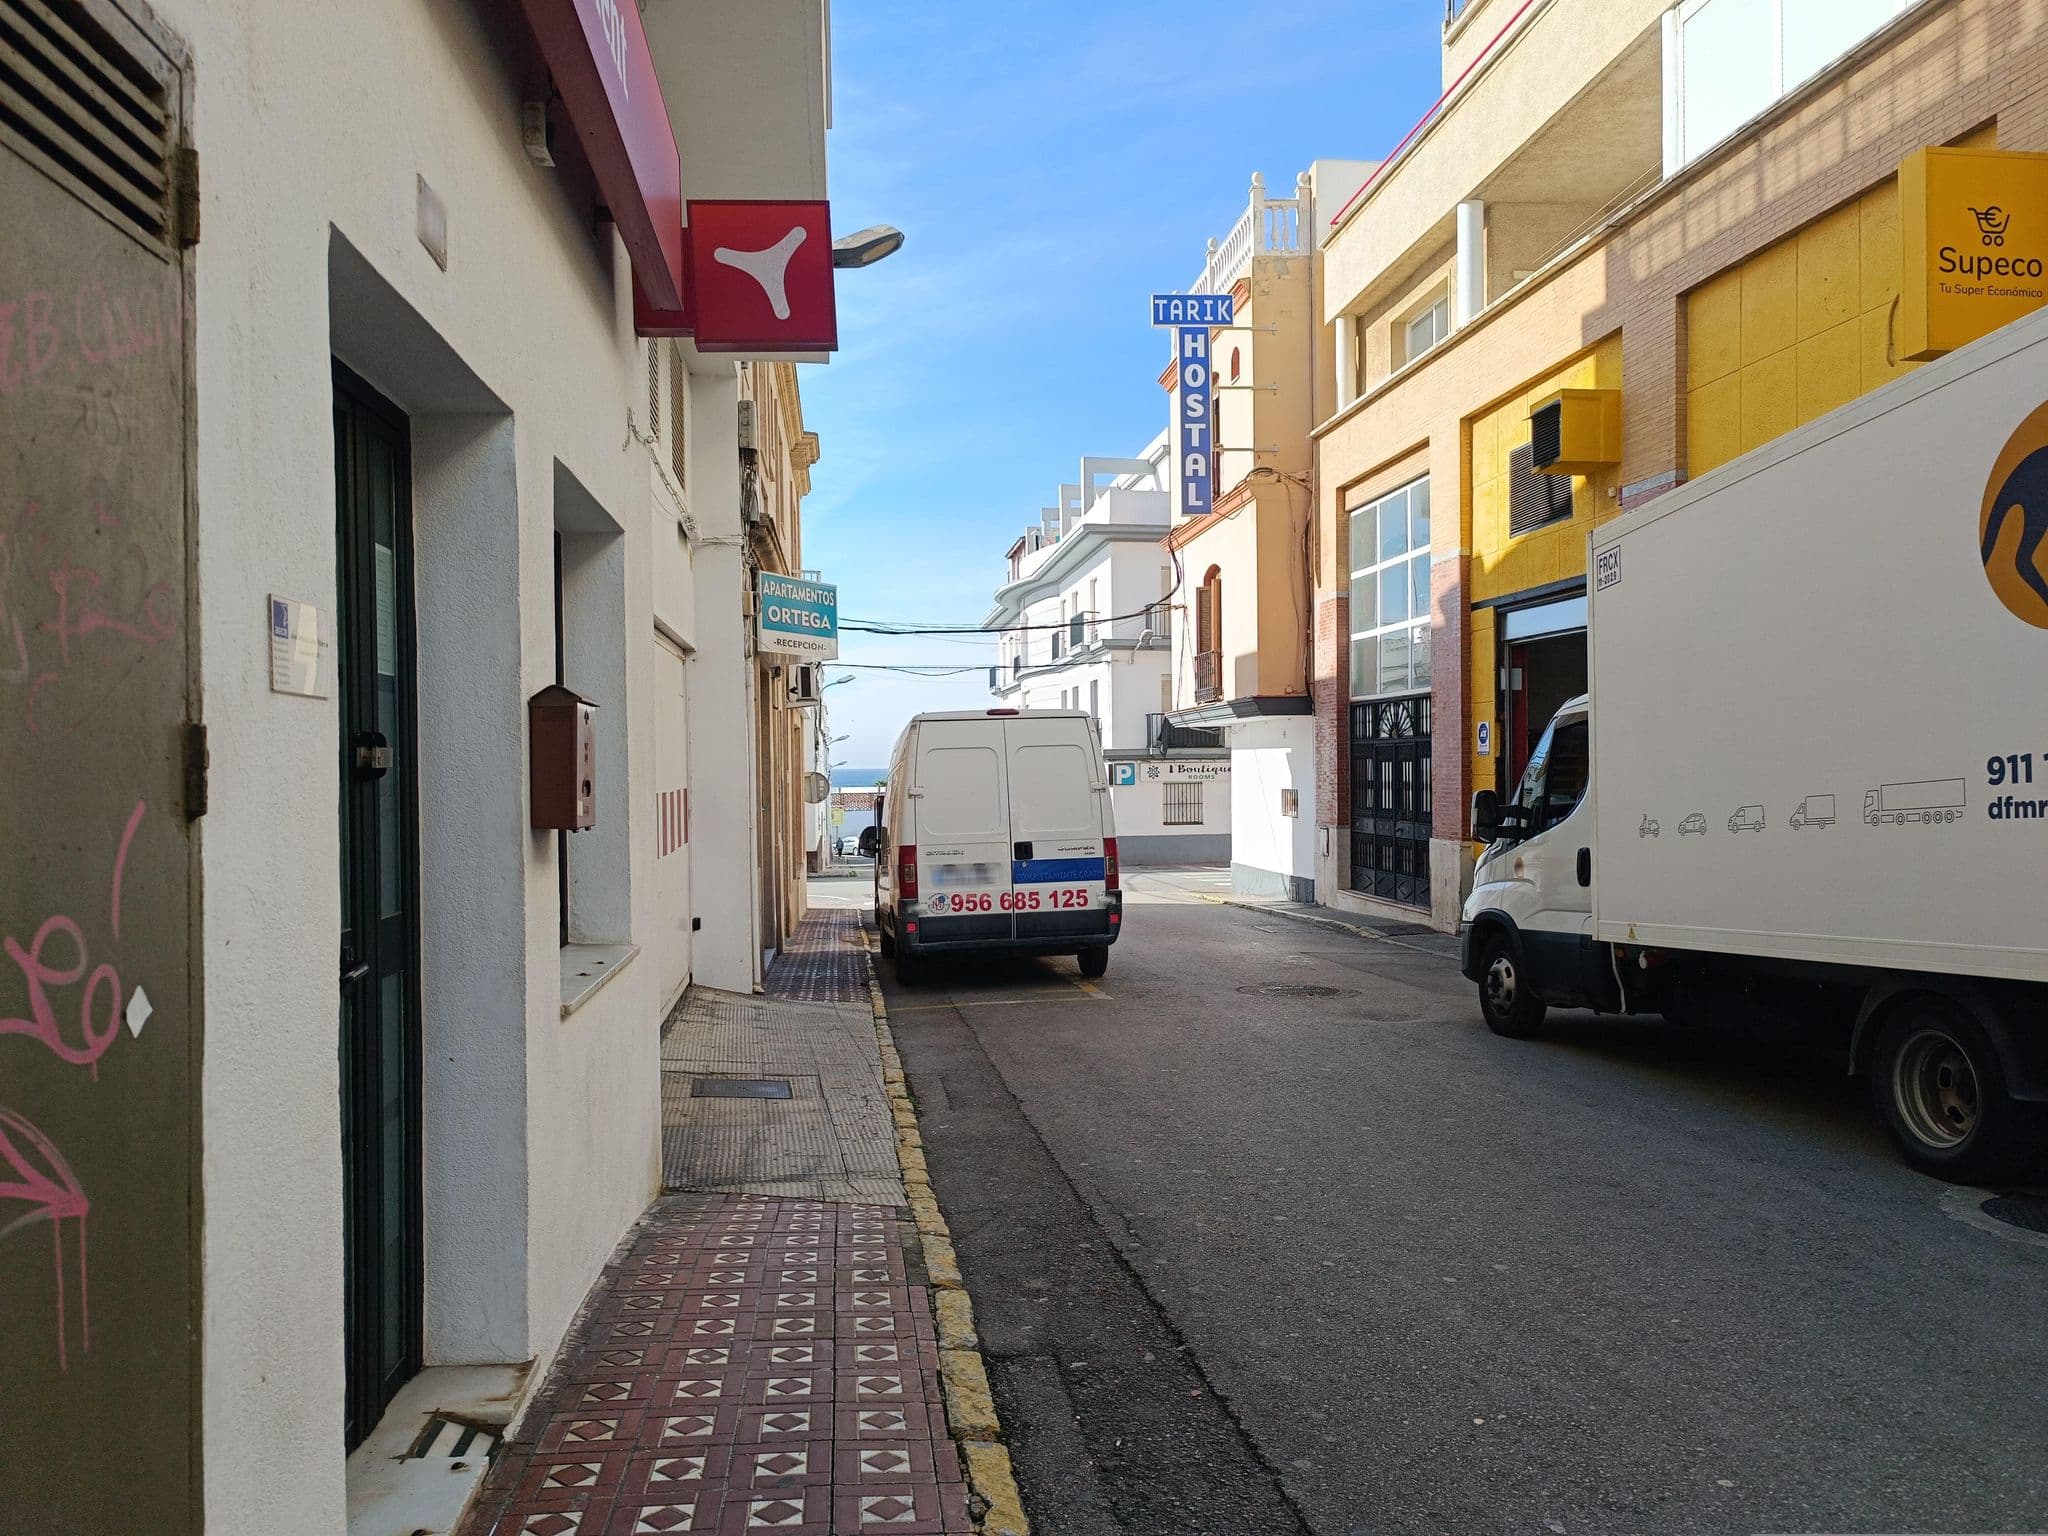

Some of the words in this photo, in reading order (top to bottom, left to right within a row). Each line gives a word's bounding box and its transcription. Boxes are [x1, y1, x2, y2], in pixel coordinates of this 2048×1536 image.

[1939, 246, 2043, 281] Supeco
[1939, 282, 1952, 294] Tu
[1954, 284, 1985, 297] Super
[1987, 285, 2043, 298] Económico
[1154, 299, 1232, 321] TARIK
[1184, 334, 1206, 506] HOSTAL
[763, 581, 834, 606] APARTAMENTOS
[768, 605, 831, 629] ORTEGA
[1116, 764, 1132, 785] P
[1986, 752, 2033, 786] 911
[951, 892, 992, 913] 956
[1000, 891, 1041, 911] 685
[1048, 889, 1089, 909] 125
